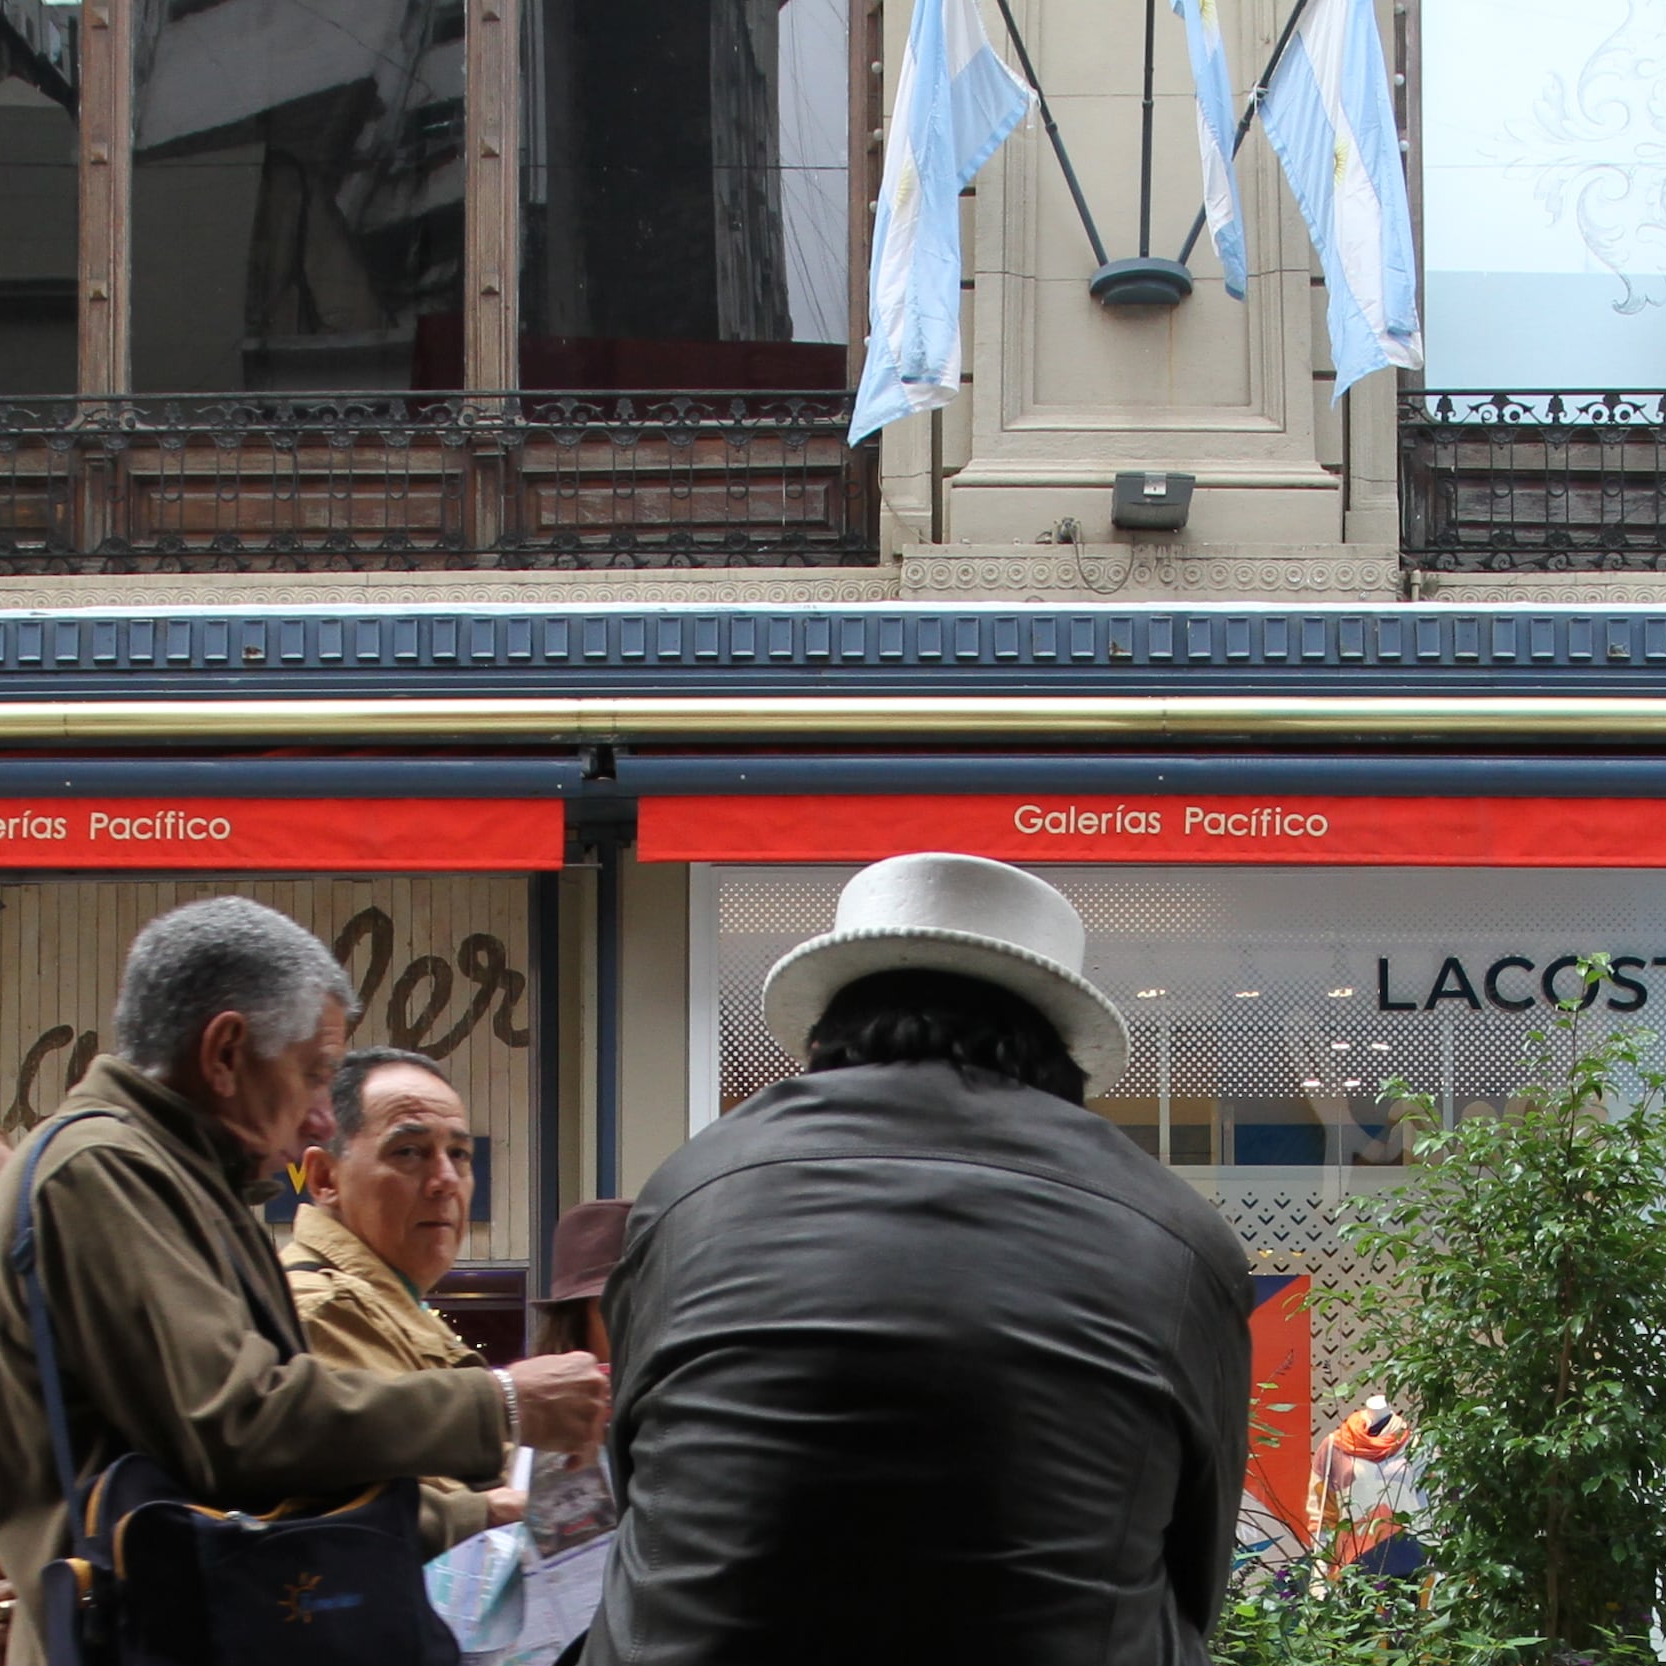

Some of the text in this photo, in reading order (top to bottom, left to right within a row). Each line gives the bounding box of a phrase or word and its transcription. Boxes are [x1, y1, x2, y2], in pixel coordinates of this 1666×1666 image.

[89, 810, 231, 840] Pacífico
[1014, 804, 1329, 837] Galerías Pacífico
